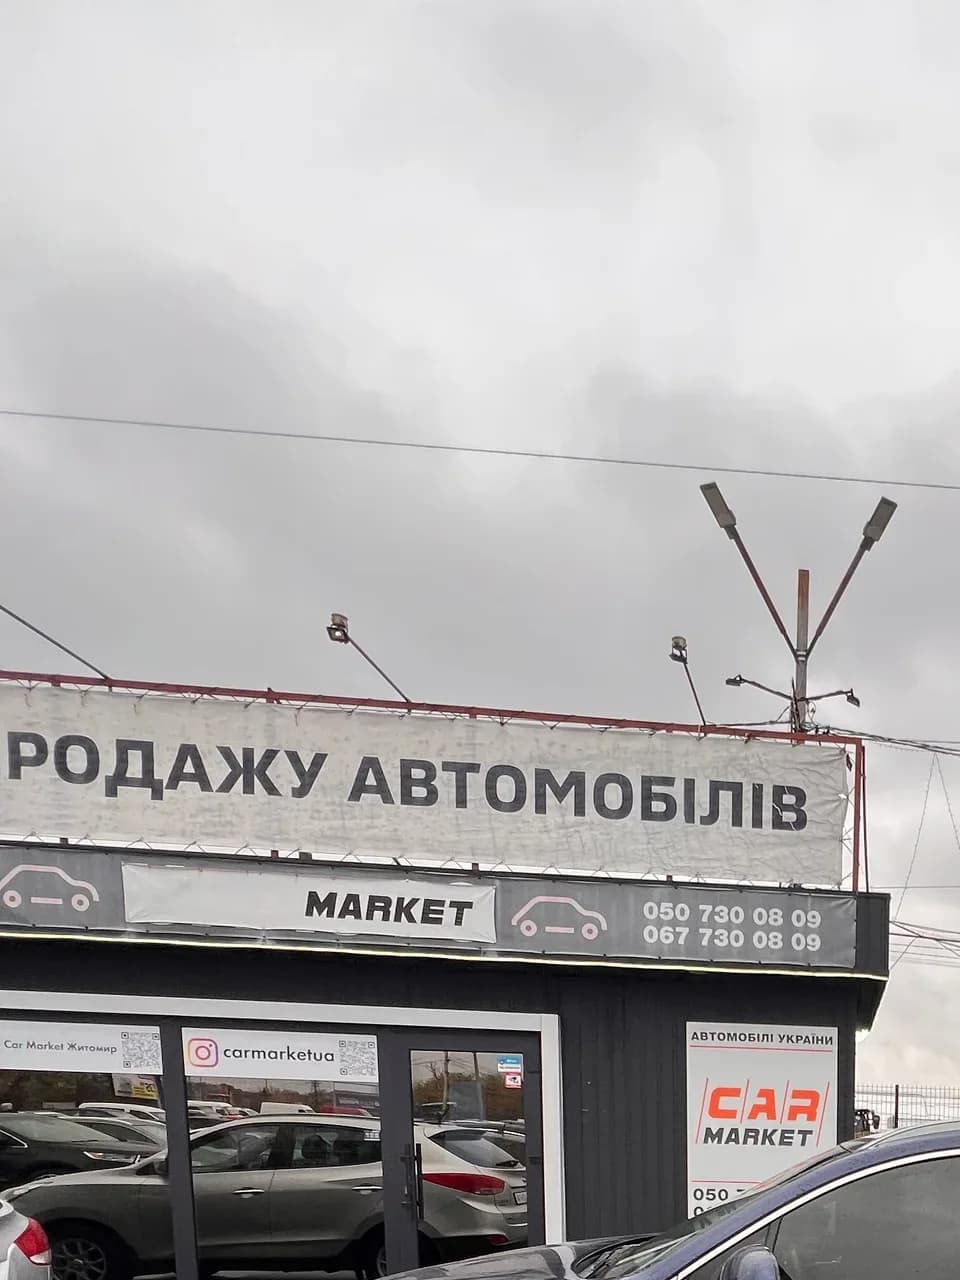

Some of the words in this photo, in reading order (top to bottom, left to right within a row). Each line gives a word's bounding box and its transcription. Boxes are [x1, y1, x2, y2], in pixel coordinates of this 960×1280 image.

[7, 731, 327, 800] РОДАЖУ
[347, 756, 808, 831] АВТОМОБІЛІВ
[304, 891, 473, 926] MARKET
[643, 902, 690, 921] 050
[699, 905, 744, 924] 730
[753, 907, 783, 926] 08
[791, 909, 821, 928] 09
[643, 925, 689, 945] 067
[699, 928, 744, 947] 730
[752, 931, 783, 949] 08
[791, 933, 821, 951] 09
[4, 1040, 23, 1049] Car
[26, 1041, 63, 1051] Market
[67, 1042, 117, 1055] Житомир
[691, 1031, 774, 1043] АВТОМОБІЛІ
[778, 1033, 833, 1045] УКРАЇНИ
[223, 1046, 335, 1062] carmarketua
[708, 1087, 820, 1121] CAR
[703, 1127, 813, 1147] MARKET
[693, 1188, 729, 1201] 050
